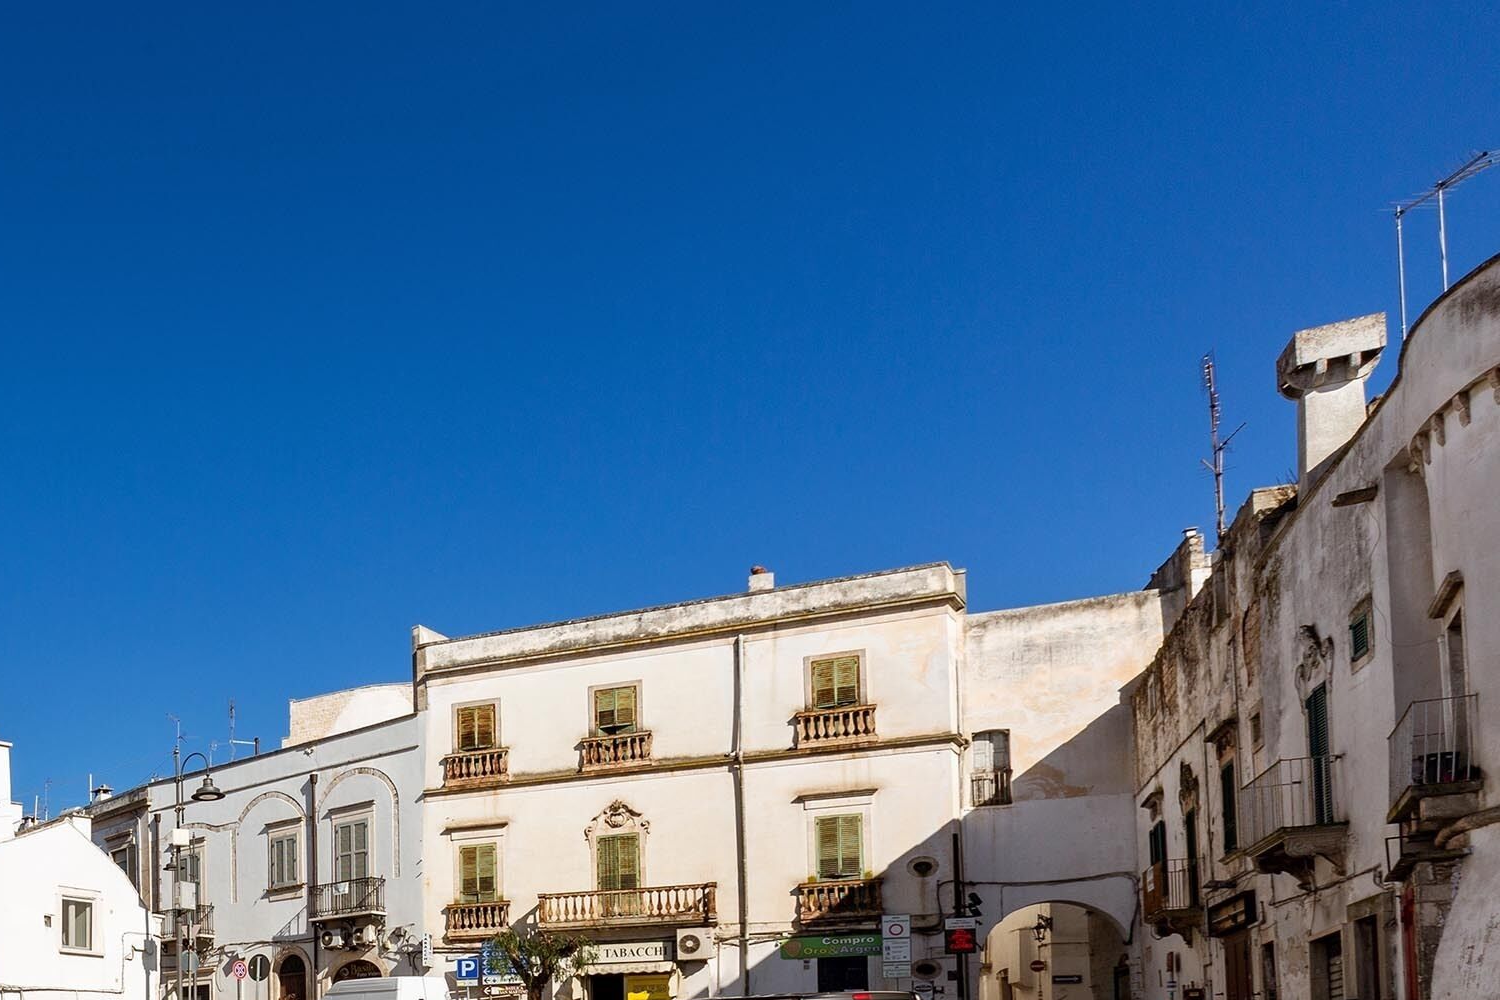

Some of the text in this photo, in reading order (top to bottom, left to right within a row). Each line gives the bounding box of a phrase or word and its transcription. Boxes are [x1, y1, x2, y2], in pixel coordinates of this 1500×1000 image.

[822, 936, 874, 945] Compro
[603, 946, 668, 958] TABACCHI
[461, 961, 475, 977] P
